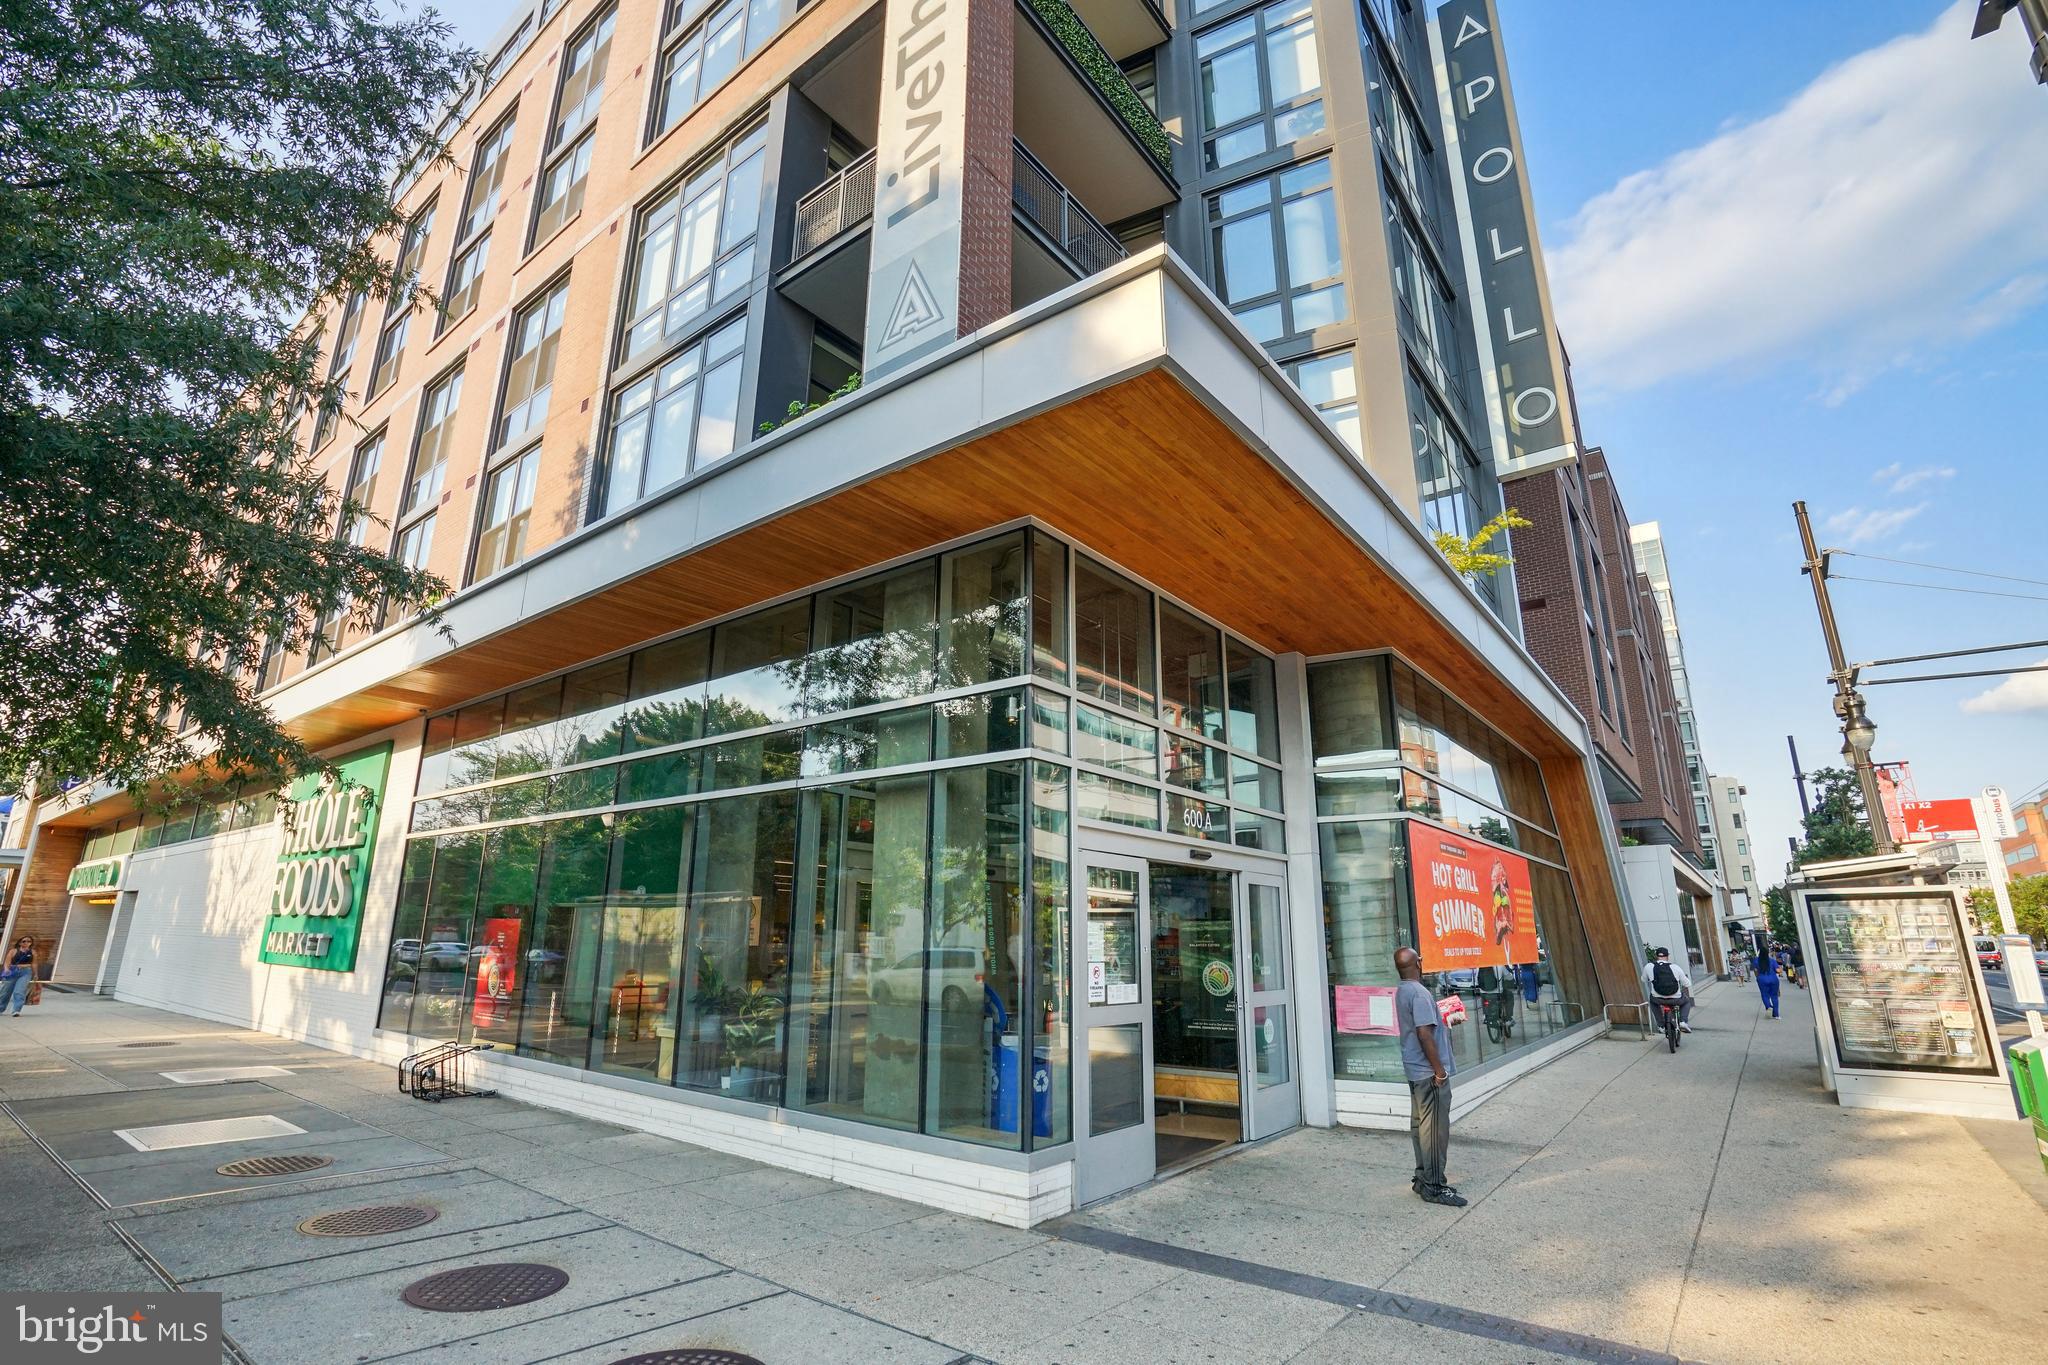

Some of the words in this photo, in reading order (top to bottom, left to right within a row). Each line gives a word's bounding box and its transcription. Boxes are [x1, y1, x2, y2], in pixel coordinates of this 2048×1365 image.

[1453, 13, 1558, 428] APOLLO
[1183, 808, 1203, 829] 600
[1204, 812, 1213, 831] A
[1993, 798, 2008, 836] metrobus
[271, 853, 355, 918] FOODS
[1431, 860, 1453, 889] HOT
[1454, 866, 1479, 893] GRILL
[1432, 899, 1486, 939] SUMMER
[265, 930, 330, 958] MARKET
